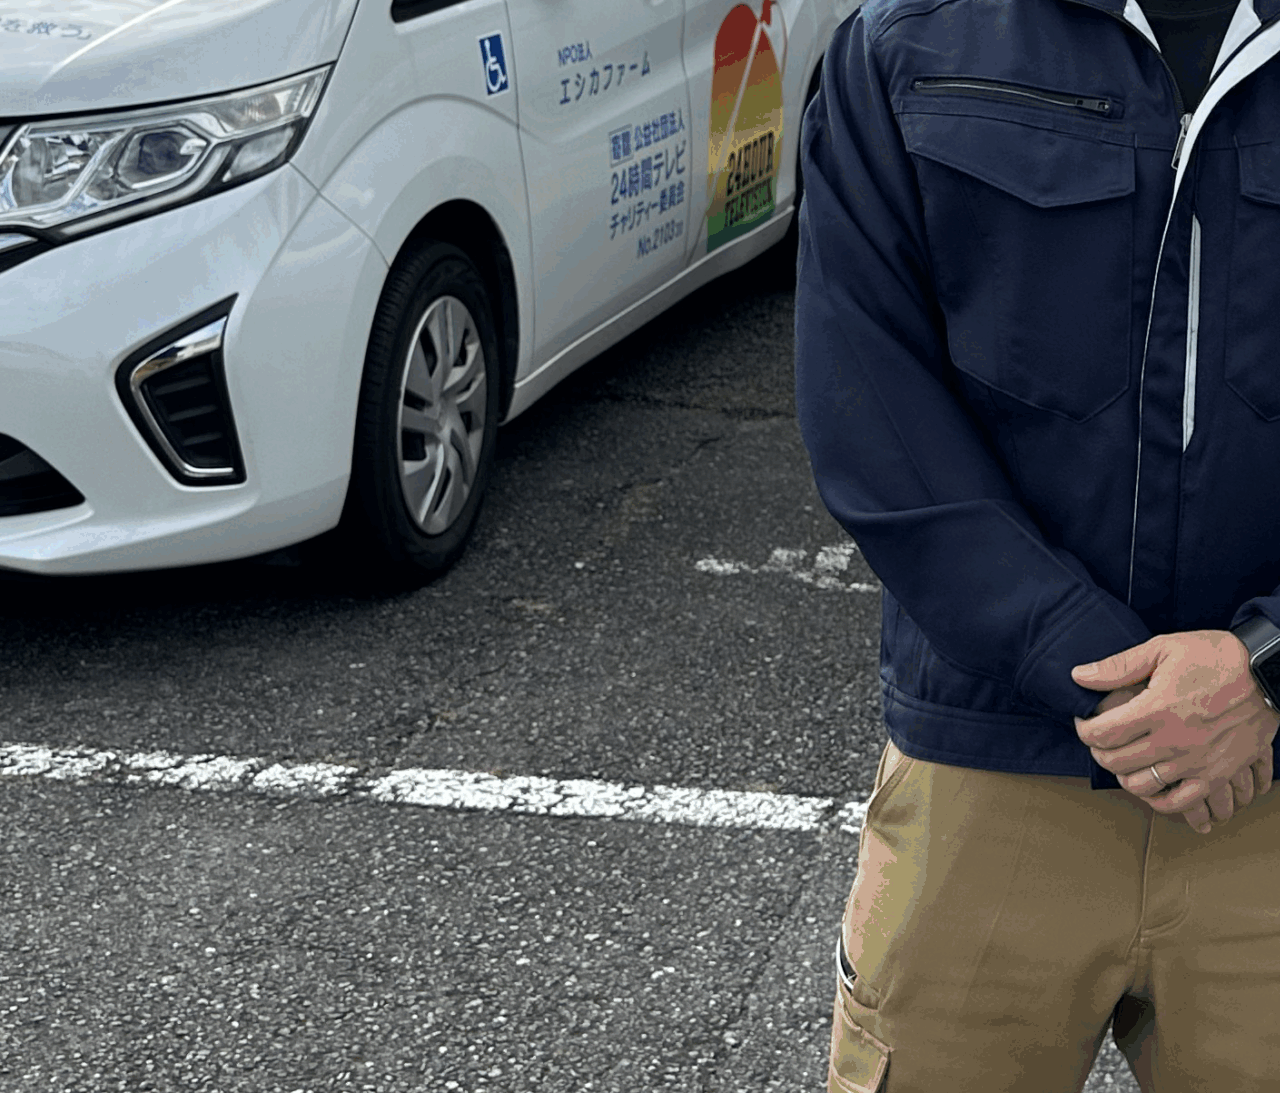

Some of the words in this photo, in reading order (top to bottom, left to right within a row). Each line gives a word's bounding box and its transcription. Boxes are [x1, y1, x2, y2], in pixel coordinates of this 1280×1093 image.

[559, 50, 651, 105] エシカファーム
[611, 139, 687, 205] 24時間テレビ
